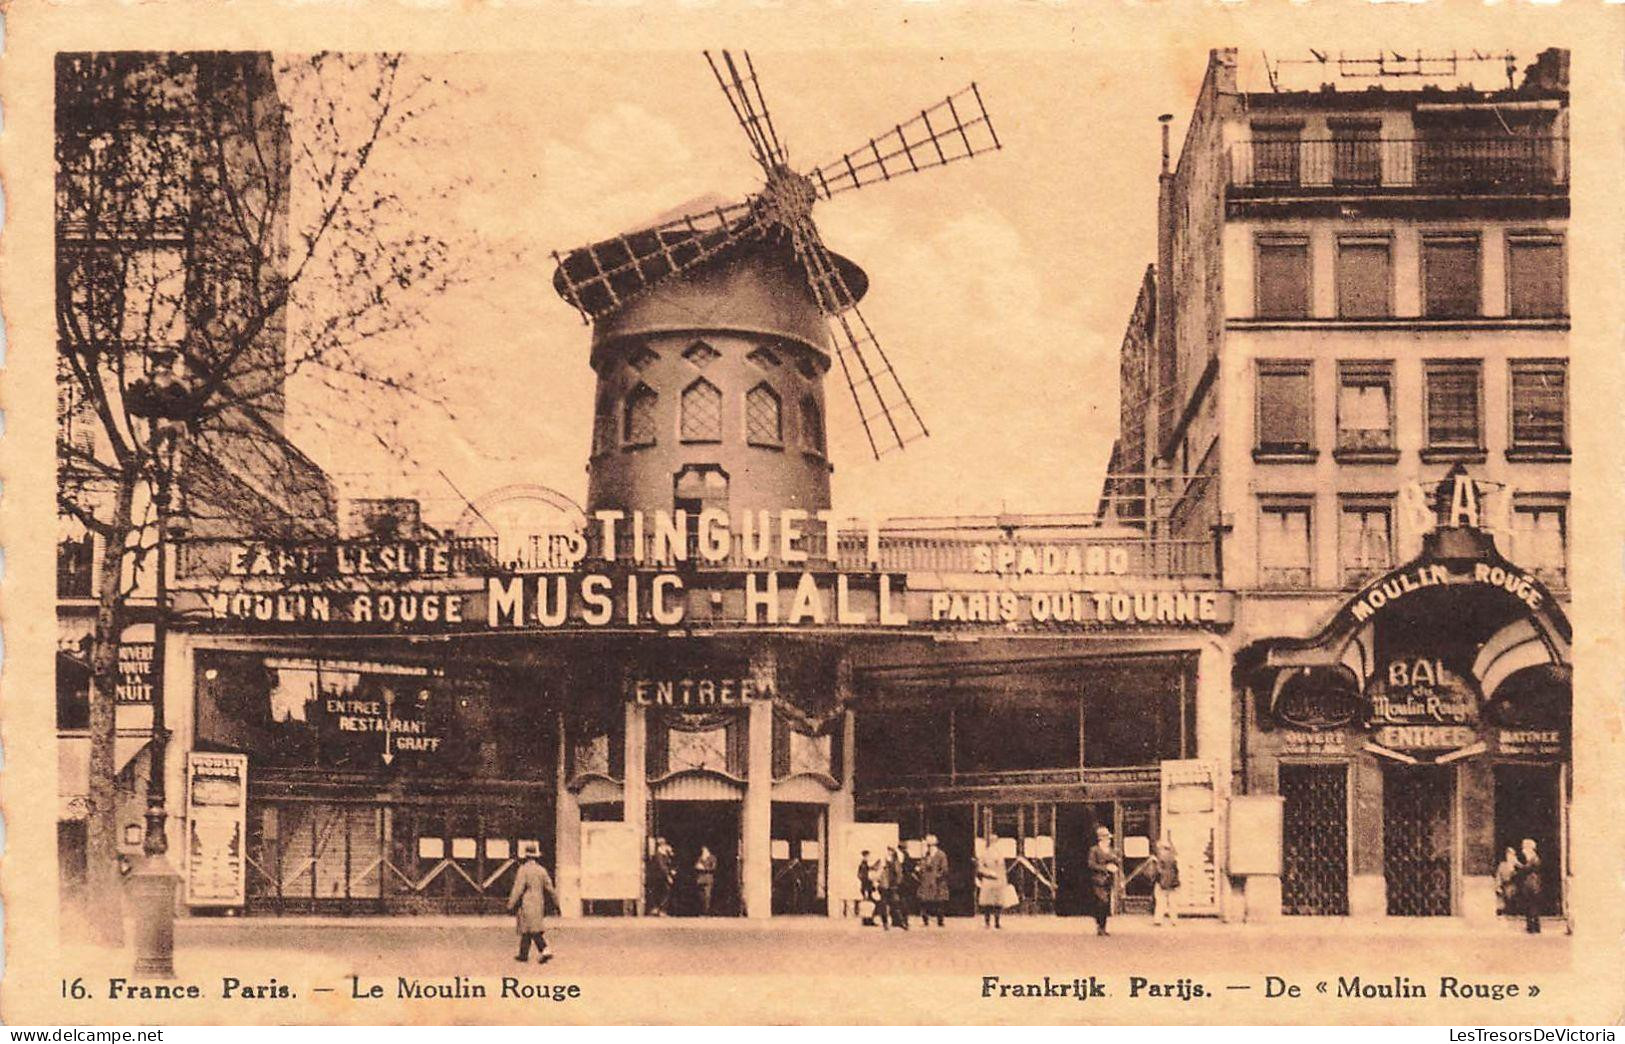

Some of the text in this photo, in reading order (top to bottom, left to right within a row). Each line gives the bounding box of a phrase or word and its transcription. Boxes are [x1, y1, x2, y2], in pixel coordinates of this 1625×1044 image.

[974, 547, 1129, 574] SPADARO
[488, 573, 908, 627] MUSIC HALL
[1351, 563, 1542, 621] MOULIN ROUGE
[207, 595, 461, 621] MOULIN ROUGE
[932, 591, 1018, 621] PARIS
[1093, 591, 1217, 621] TOURNE
[1389, 659, 1461, 686] BAL
[115, 685, 154, 701] NUIT
[636, 679, 755, 705] ENTREE
[327, 700, 381, 715] ENTREE
[340, 716, 427, 733] RESTAURANT
[397, 737, 441, 752] GRAFF
[222, 977, 297, 999] Paris.
[351, 975, 384, 999] Le
[397, 976, 486, 999] Moulin
[501, 977, 581, 1001] Rouge
[1129, 976, 1212, 1000] Parijs.
[1265, 976, 1301, 998] De
[1337, 976, 1426, 998] Moulin
[1440, 976, 1519, 1000] Rouge
